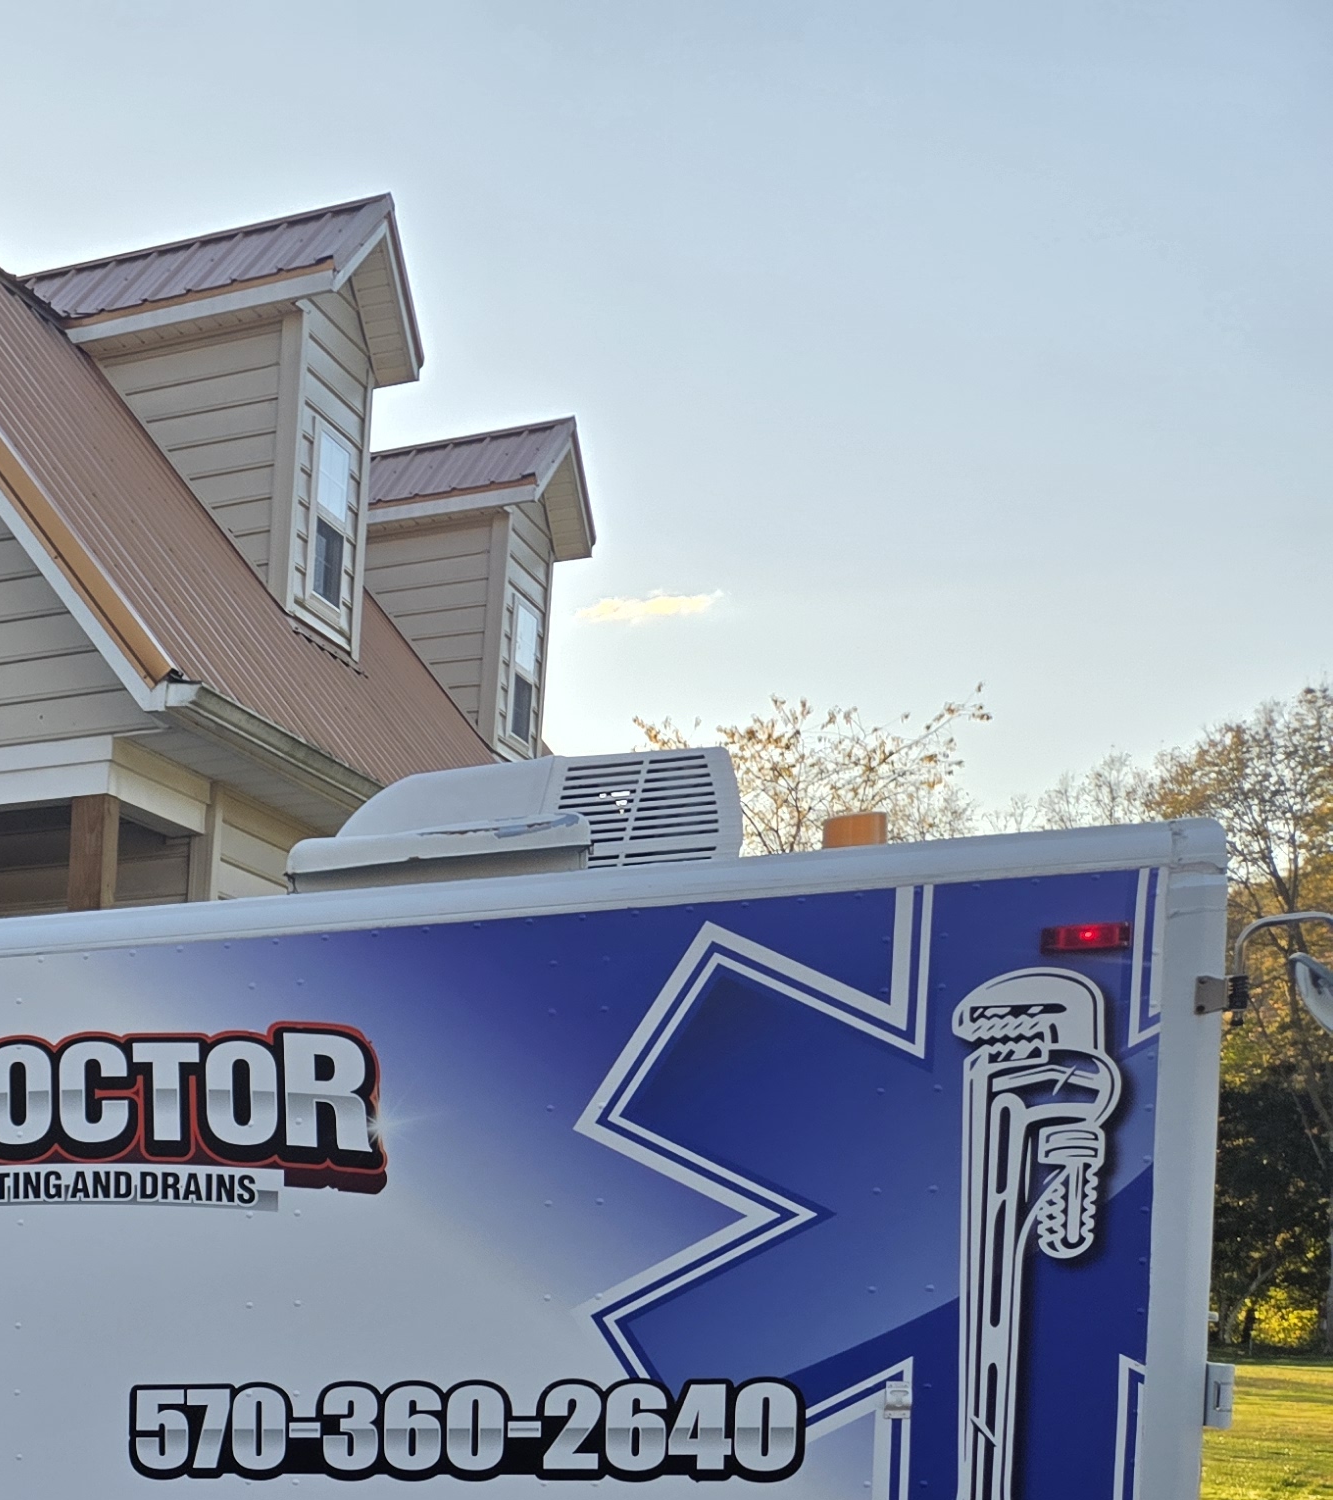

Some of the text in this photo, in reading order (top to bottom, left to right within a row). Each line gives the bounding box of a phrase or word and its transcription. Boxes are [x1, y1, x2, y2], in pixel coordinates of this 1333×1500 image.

[70, 1170, 132, 1200] AND
[139, 1171, 257, 1205] DRAINS
[134, 1381, 798, 1473] 570-360-2640
